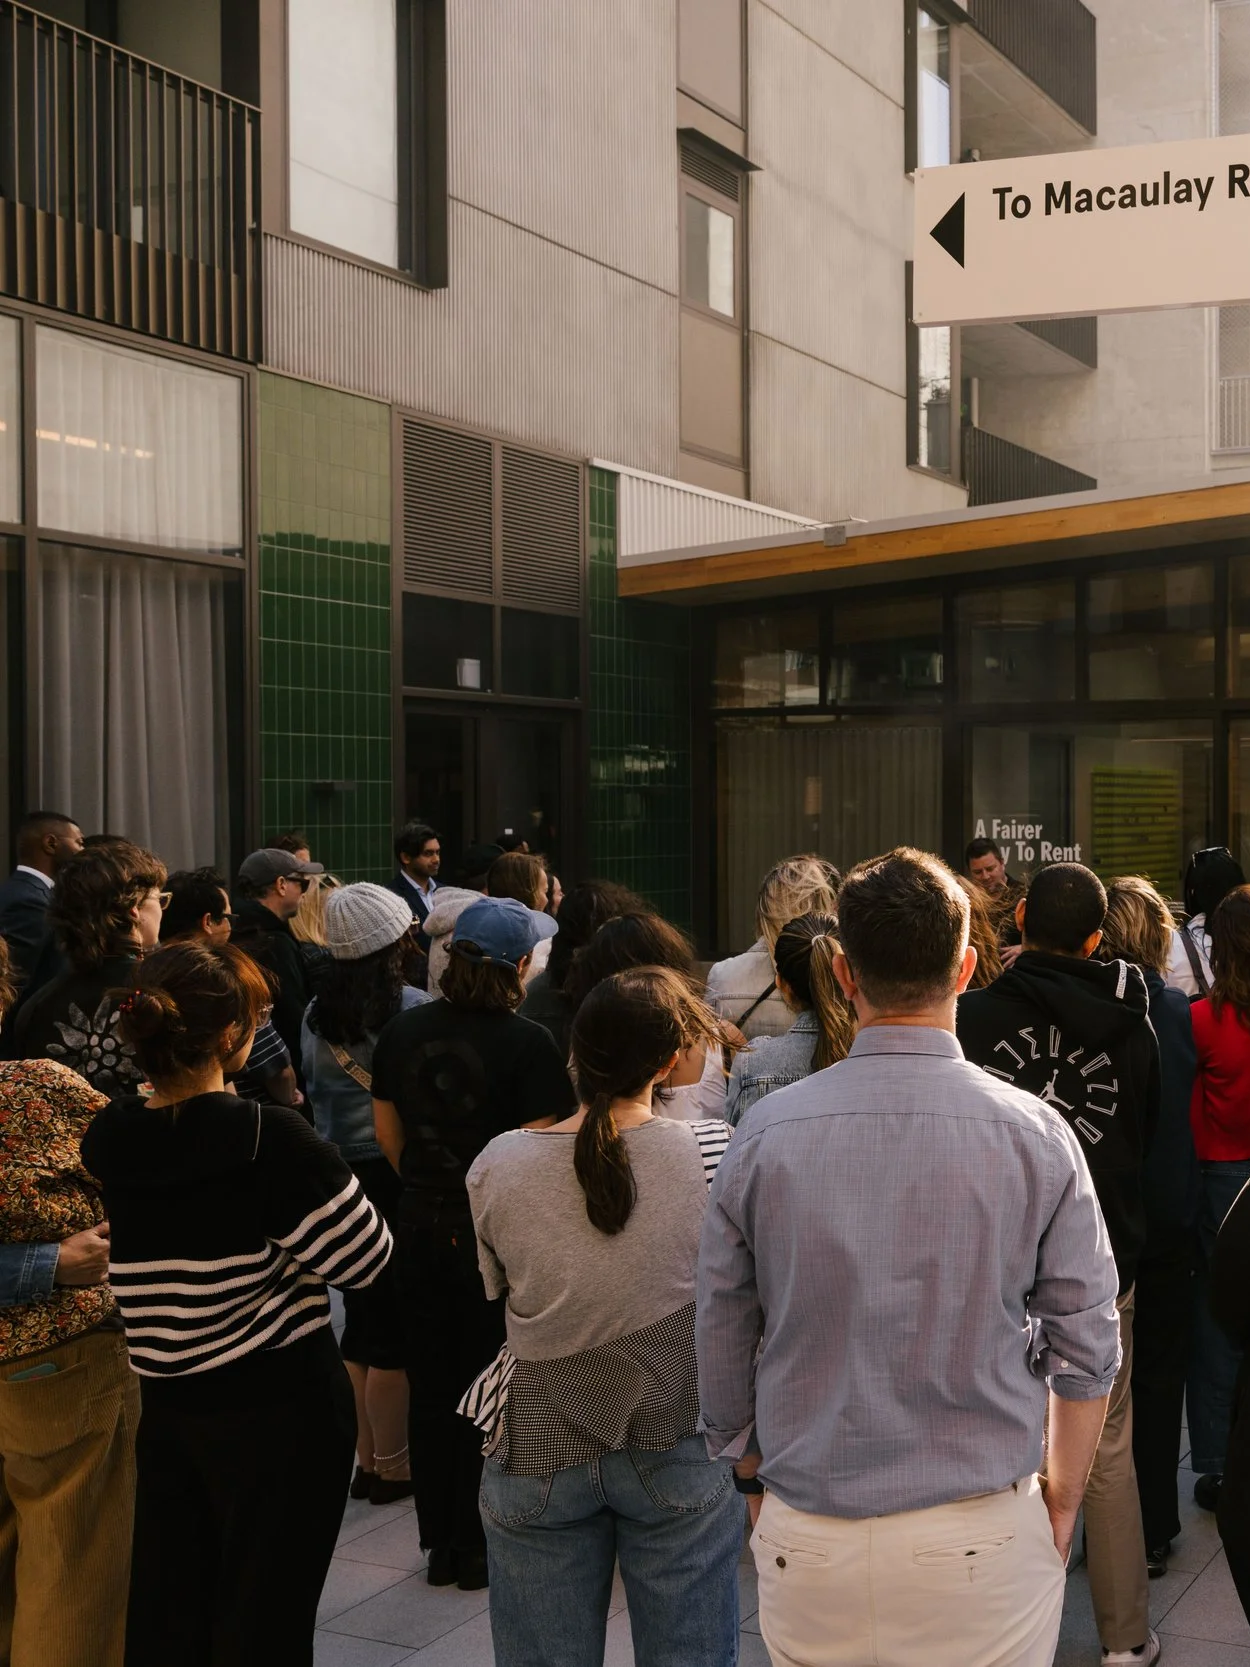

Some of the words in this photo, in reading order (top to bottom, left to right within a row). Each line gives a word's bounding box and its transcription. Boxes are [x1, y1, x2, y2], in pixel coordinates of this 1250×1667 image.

[993, 187, 1032, 220] To
[1045, 171, 1215, 216] Macaulay
[974, 818, 987, 839] A
[992, 818, 1043, 839] Fairer
[1016, 841, 1035, 862] To
[1041, 841, 1082, 862] Rent
